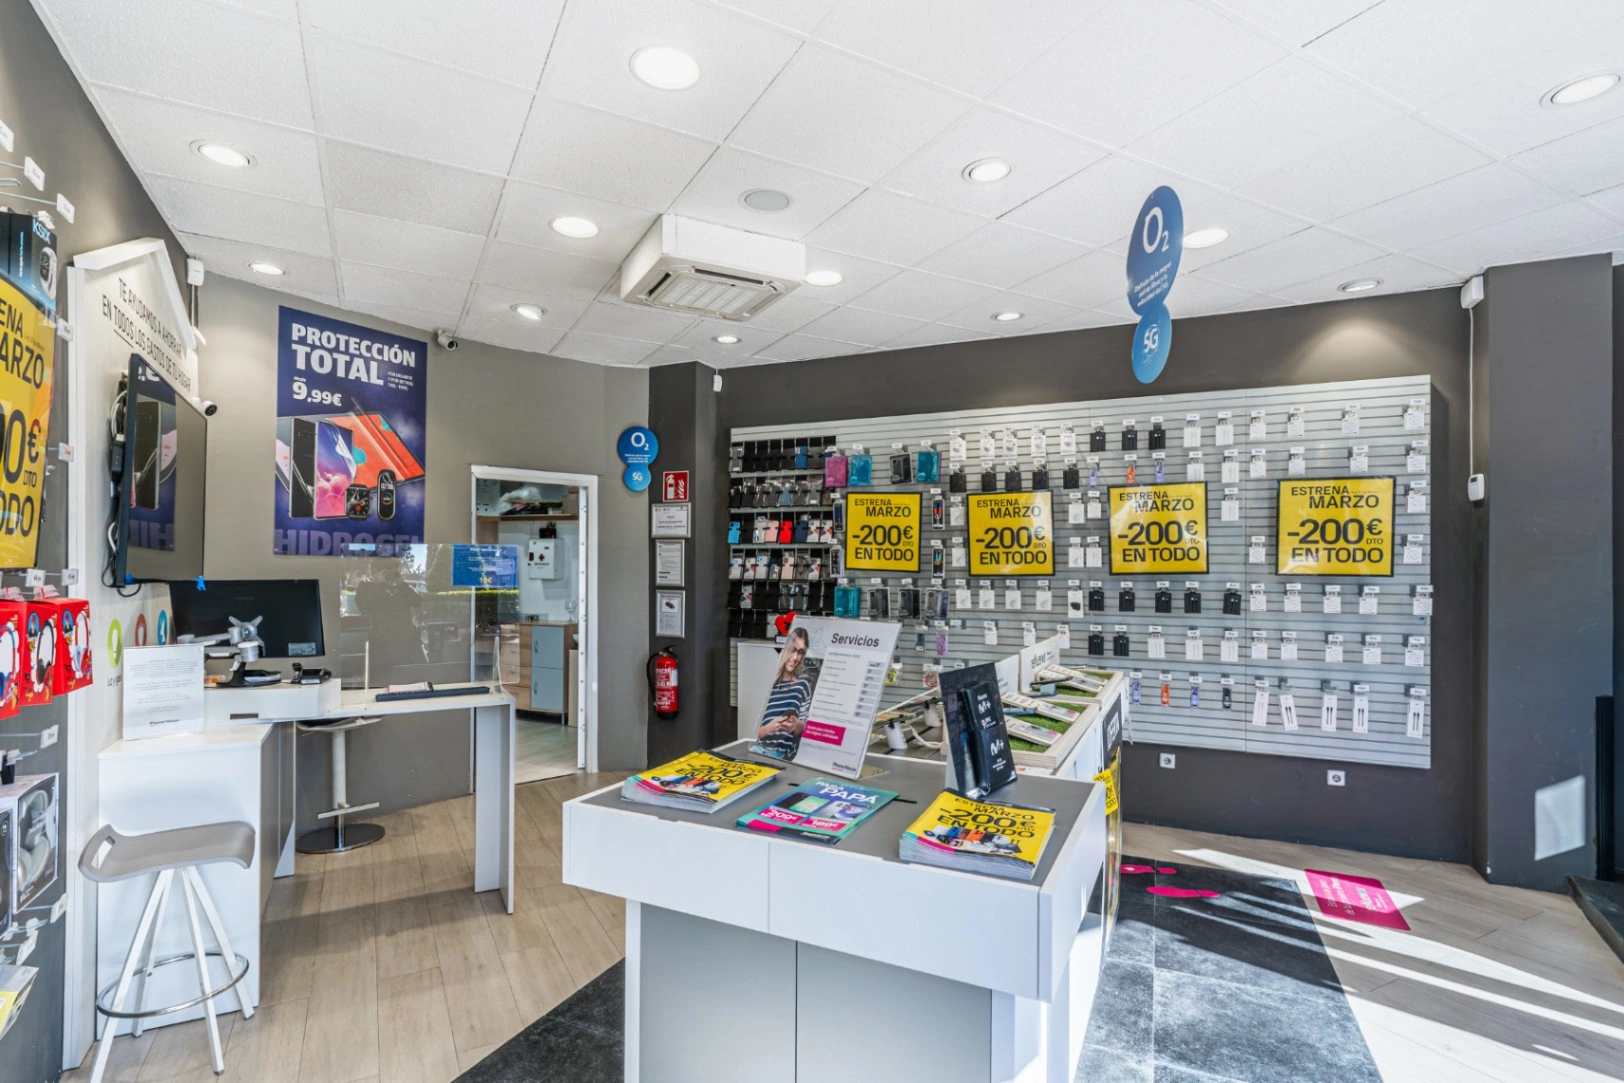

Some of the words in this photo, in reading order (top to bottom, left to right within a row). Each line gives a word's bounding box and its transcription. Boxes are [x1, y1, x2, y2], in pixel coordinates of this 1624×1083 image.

[291, 322, 415, 368] PROTECCIÓN
[291, 343, 384, 386] TOTAL
[1119, 491, 1168, 502] ESTRENA
[1291, 486, 1349, 496] ESTRENA
[854, 498, 892, 506] ESTRENA
[977, 498, 1019, 508] ESTRENA
[1134, 498, 1194, 513] MARZO
[1309, 494, 1379, 509] MARZO
[866, 506, 911, 518] MARZO
[990, 505, 1042, 519] MARZO
[855, 548, 872, 560] EN
[875, 548, 914, 562] TODO
[979, 551, 1000, 565] EN
[1002, 551, 1047, 565] TODO
[1122, 549, 1146, 563] EN
[1150, 547, 1200, 562] TODO
[1291, 547, 1319, 564] EN
[1323, 547, 1384, 564] TODO
[831, 632, 880, 648] Servicios
[955, 798, 1004, 811] ESTRENA
[974, 807, 1034, 821] MARZO
[937, 815, 968, 827] EN
[972, 823, 1035, 838] TODO
